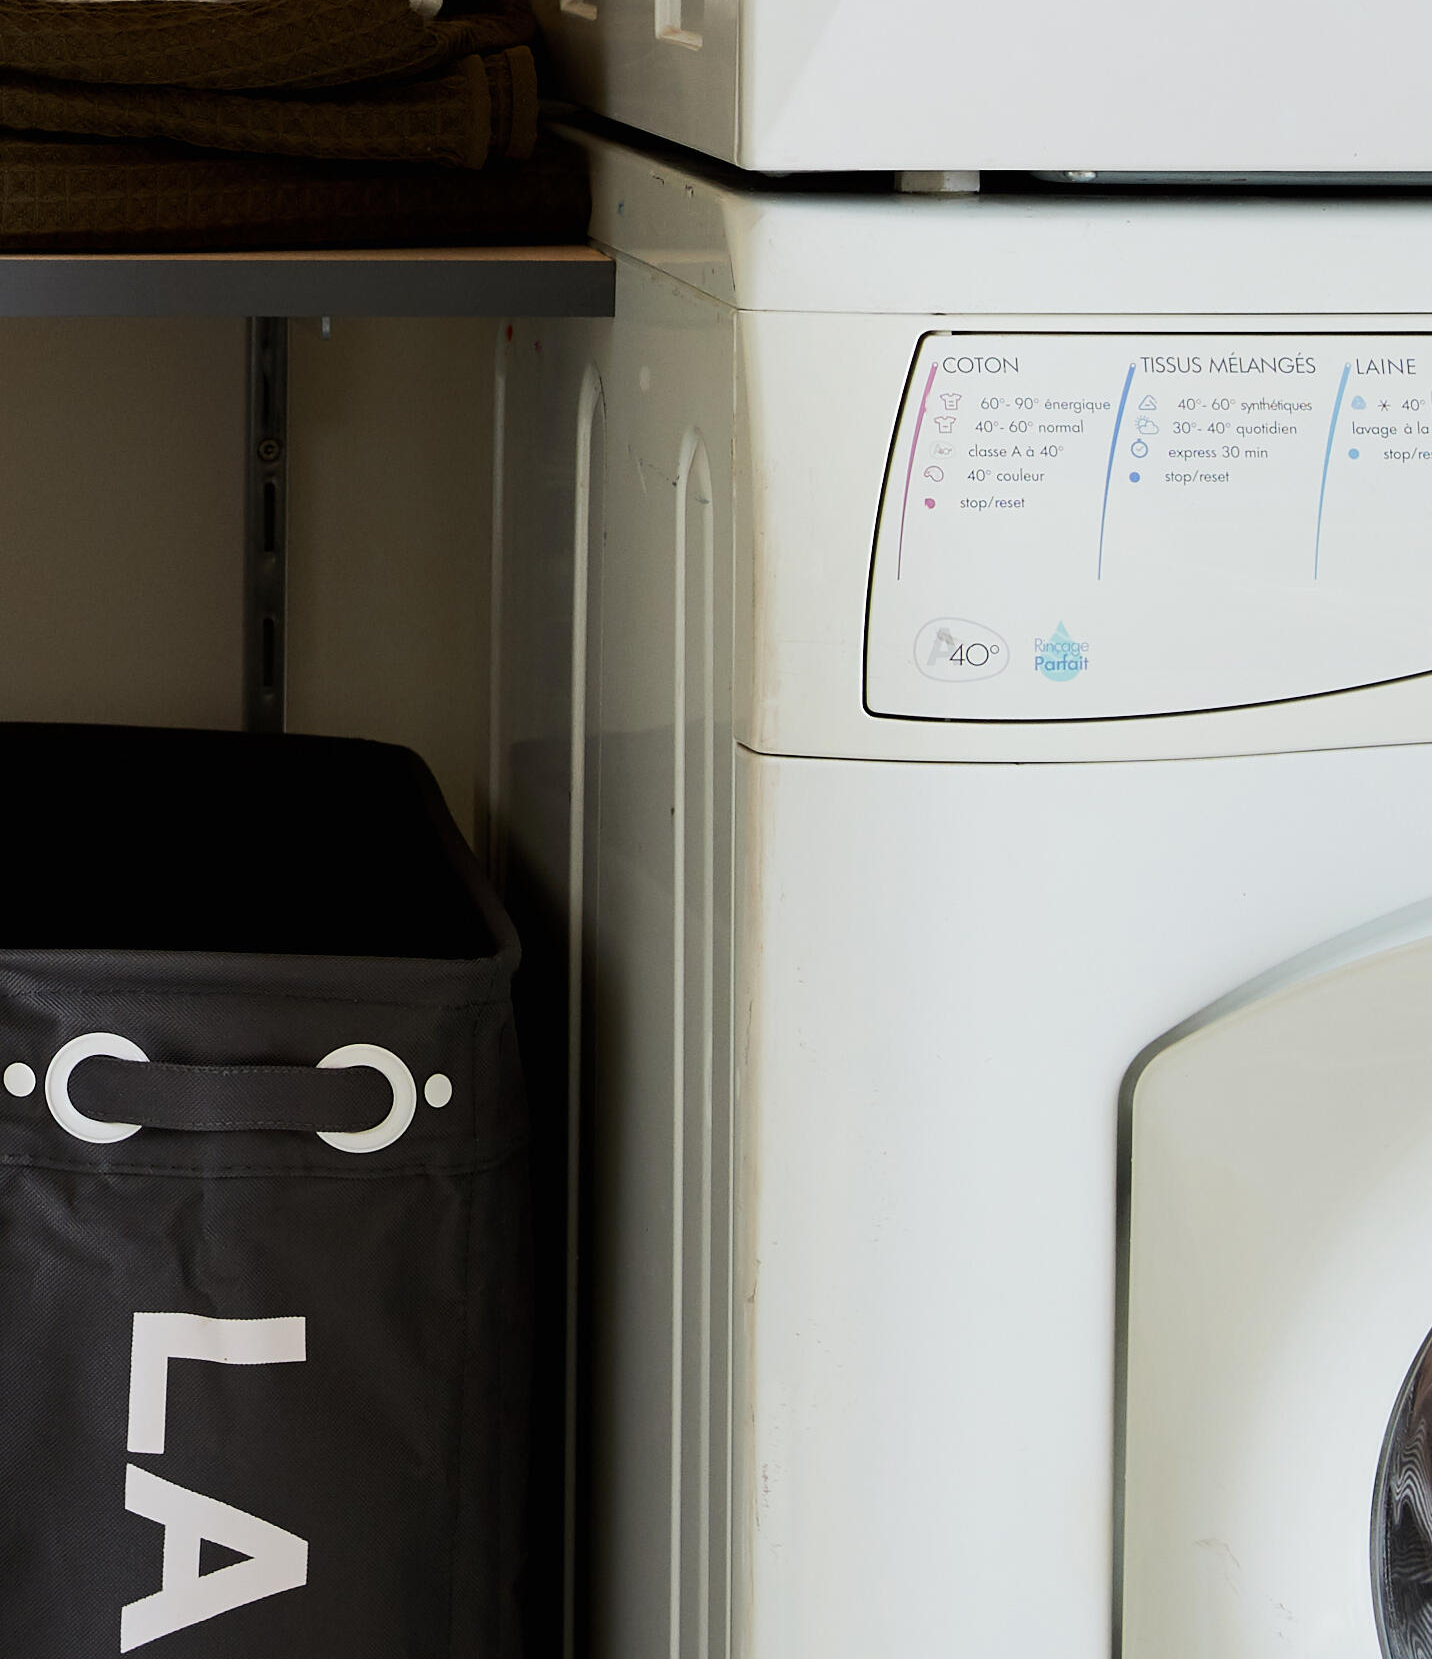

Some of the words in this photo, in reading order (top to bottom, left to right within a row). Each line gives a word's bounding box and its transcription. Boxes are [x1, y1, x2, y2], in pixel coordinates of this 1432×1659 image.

[942, 357, 1019, 374] COTON
[1140, 357, 1203, 374] TISSUS
[1209, 351, 1317, 375] MÉLANGÉS
[1355, 358, 1417, 375] LAINE
[1014, 397, 1039, 411] 90°
[1044, 398, 1111, 414] énergique
[1211, 398, 1236, 411] 60°
[1240, 397, 1313, 415] synthétiques
[1401, 398, 1426, 411] 40°
[1008, 420, 1034, 433] 60°
[1038, 419, 1084, 433] normal
[1207, 421, 1231, 434] 40°
[1236, 421, 1297, 438] quotidien
[1351, 421, 1397, 439] lavage
[1404, 423, 1412, 434] à
[1417, 420, 1429, 434] la
[968, 443, 1007, 458] classe
[1011, 445, 1021, 457] A
[1026, 445, 1035, 457] à
[1040, 445, 1064, 458] 40°
[1168, 446, 1217, 462] express
[1221, 445, 1240, 459] 30
[1244, 446, 1269, 458] min
[967, 468, 992, 482] 40°
[996, 468, 1045, 482] couleur
[1165, 469, 1230, 486] stop/reset
[960, 496, 1025, 512] stop/reset
[1034, 653, 1089, 671] Parfait
